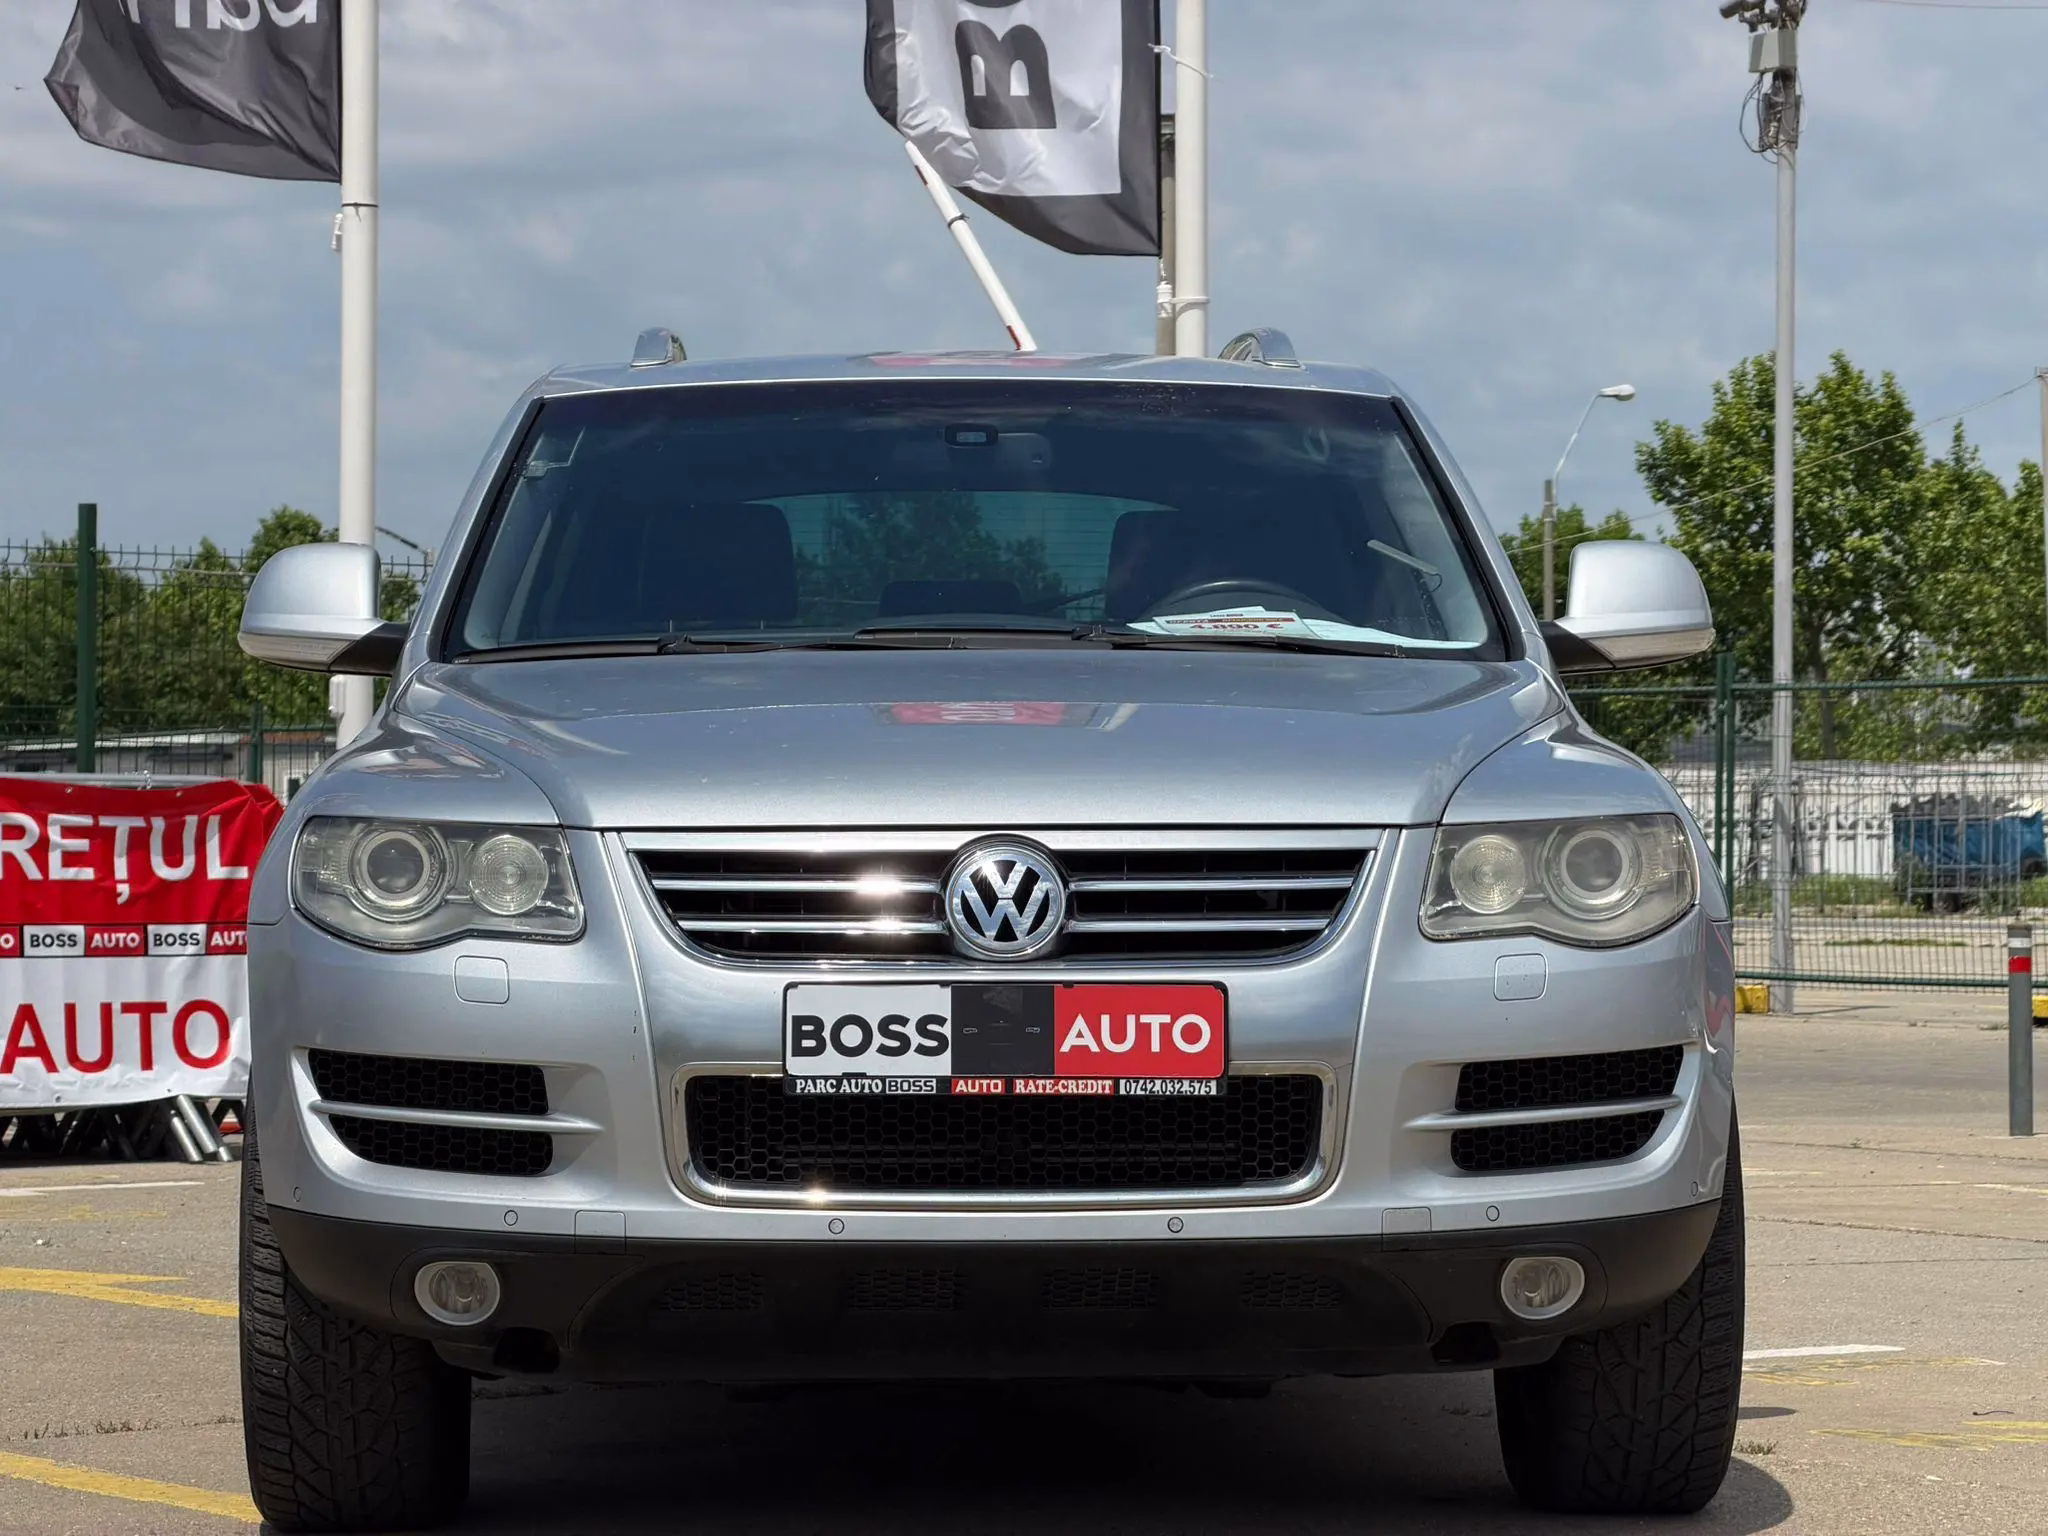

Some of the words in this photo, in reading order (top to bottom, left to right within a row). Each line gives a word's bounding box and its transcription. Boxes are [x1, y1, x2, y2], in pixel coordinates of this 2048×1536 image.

[954, 0, 1057, 129] B
[29, 933, 78, 948] BOSS
[90, 932, 140, 948] AUTO
[153, 931, 200, 947] BOSS
[210, 930, 248, 946] AUT
[0, 1000, 231, 1074] AUTO
[791, 1014, 950, 1058] BOSS
[1059, 1013, 1212, 1054] AUTO
[795, 1079, 836, 1093] PARC
[839, 1079, 882, 1093] AUTO
[887, 1079, 936, 1093] BOSS
[955, 1079, 1003, 1093] AUTO
[1014, 1079, 1112, 1094] RATE-CREDIT
[1124, 1079, 1213, 1095] 0742.032.575
